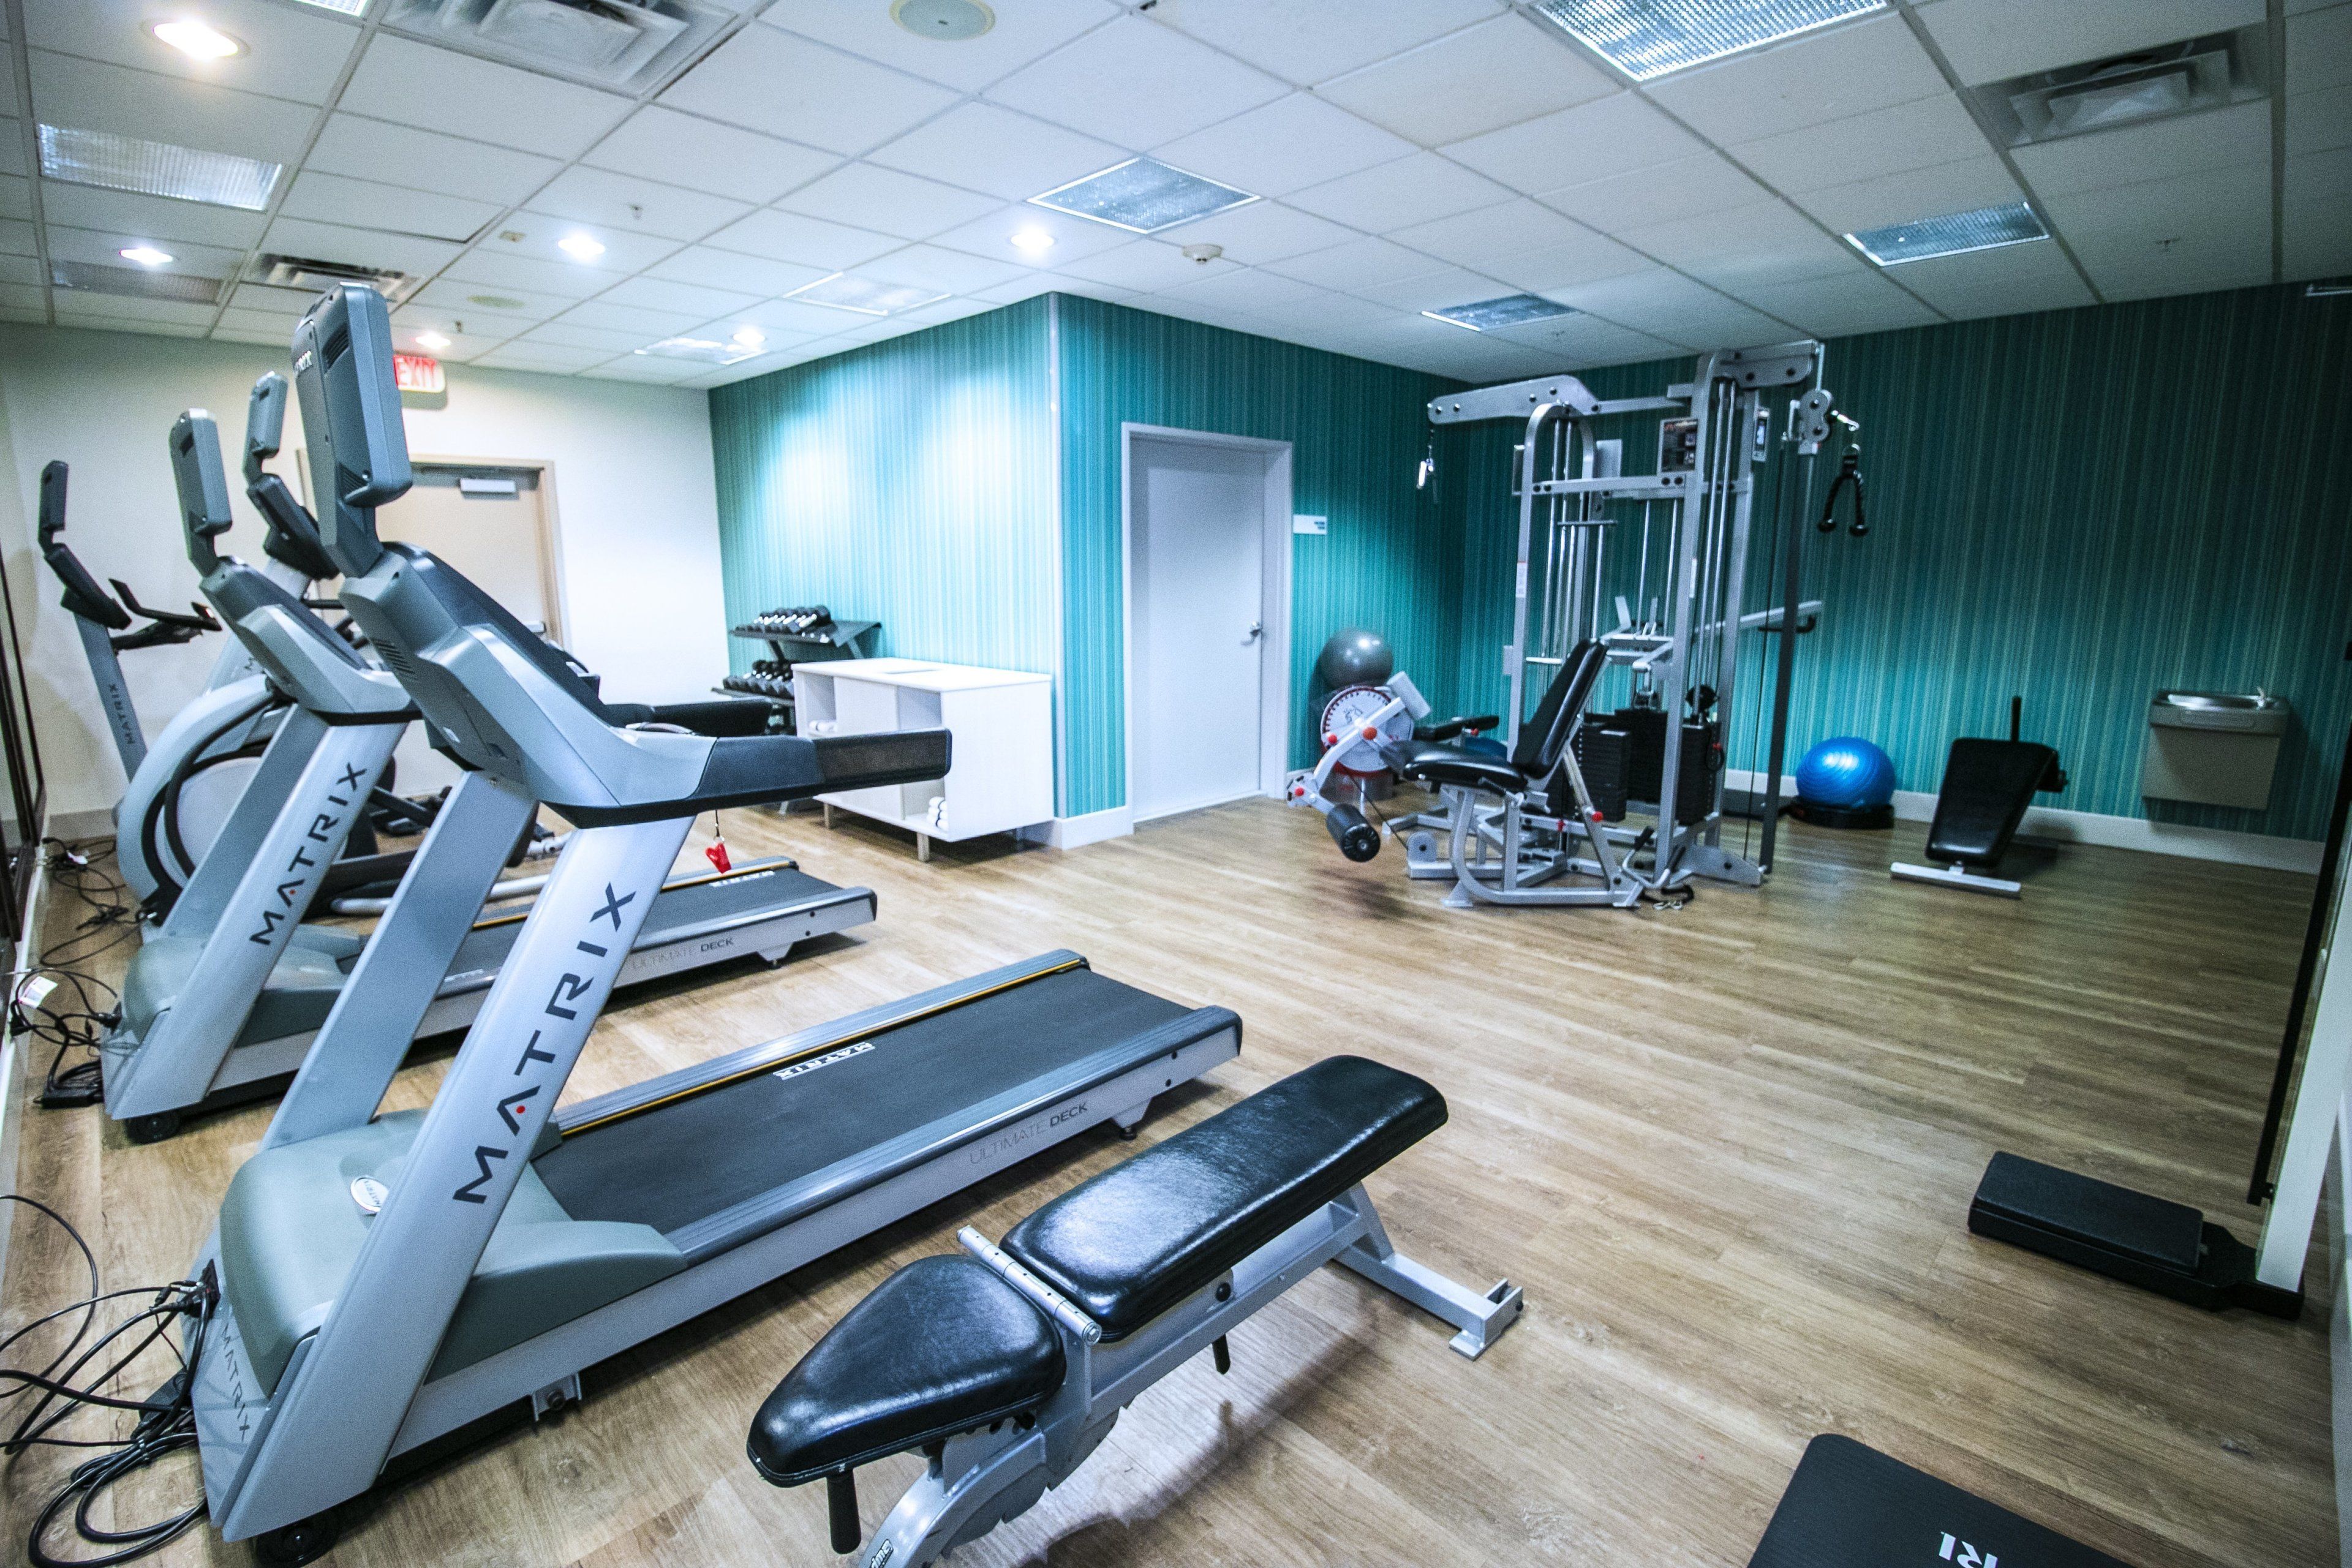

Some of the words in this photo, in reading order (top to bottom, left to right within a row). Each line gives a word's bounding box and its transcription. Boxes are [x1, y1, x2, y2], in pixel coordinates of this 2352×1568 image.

[396, 357, 437, 387] EXIT
[110, 684, 134, 745] MATRIX
[249, 762, 368, 946] MATRIX
[700, 937, 734, 952] DECK
[452, 881, 637, 1204] MATRIX
[774, 1042, 873, 1078] MATRIX
[970, 1123, 1045, 1164] ULTIMATE
[1049, 1103, 1088, 1128] DECK
[221, 1322, 251, 1443] MATRIX
